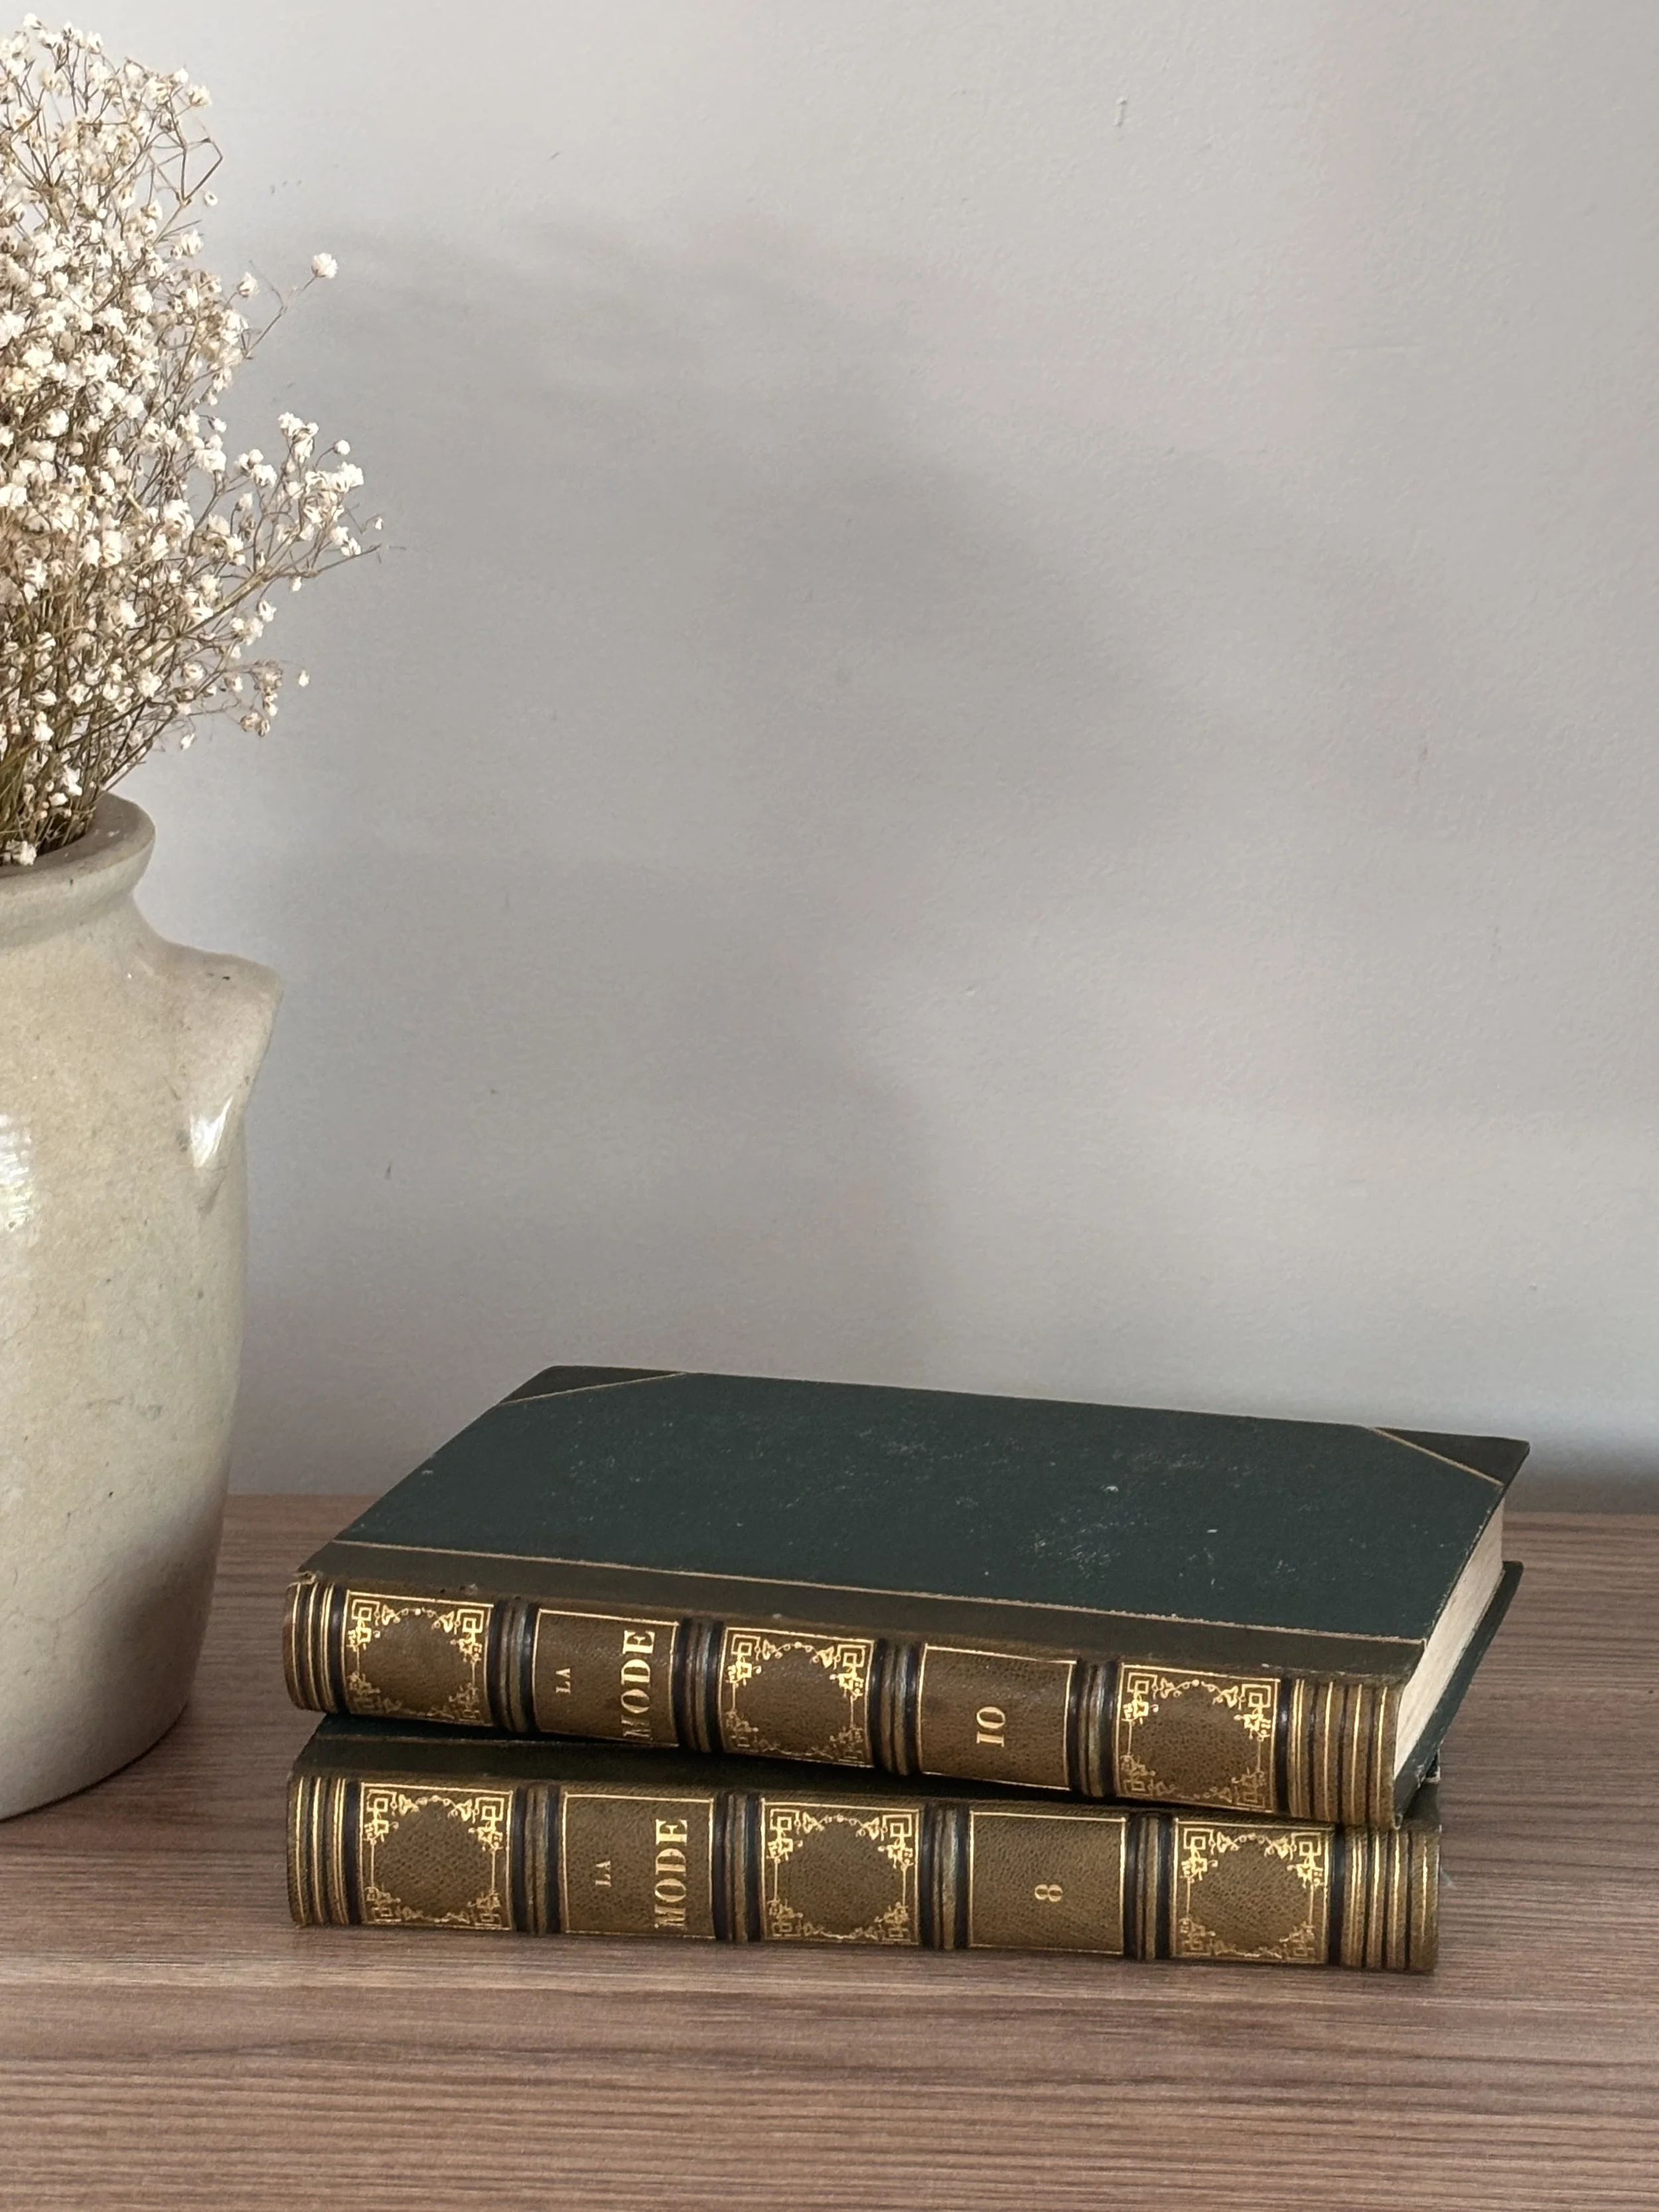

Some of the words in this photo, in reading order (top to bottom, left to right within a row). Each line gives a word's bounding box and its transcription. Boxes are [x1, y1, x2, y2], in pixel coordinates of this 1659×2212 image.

[555, 1668, 571, 1694] LA
[620, 1630, 656, 1741] MODE
[595, 1860, 612, 1887] LA
[654, 1818, 687, 1930] MODE
[1034, 1883, 1063, 1902] 8
